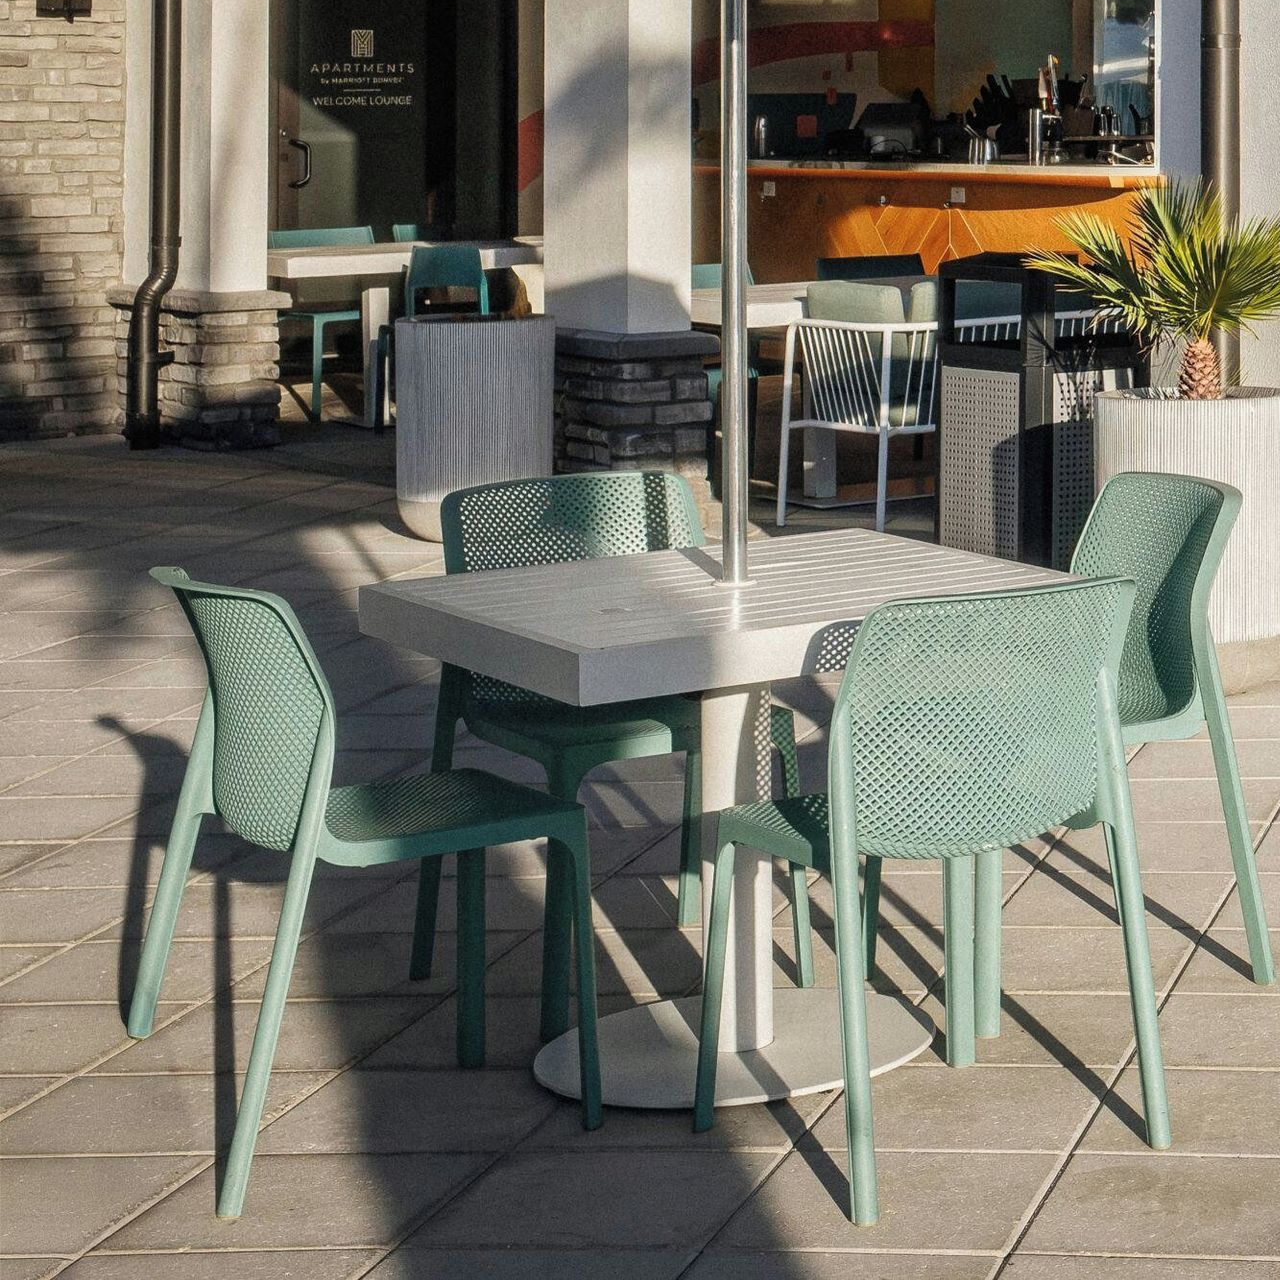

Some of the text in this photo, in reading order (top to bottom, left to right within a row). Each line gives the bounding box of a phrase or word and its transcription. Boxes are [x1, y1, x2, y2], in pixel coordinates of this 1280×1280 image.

[310, 63, 415, 74] APARTMENTS
[312, 95, 413, 106] WELCOME LOUNGE
